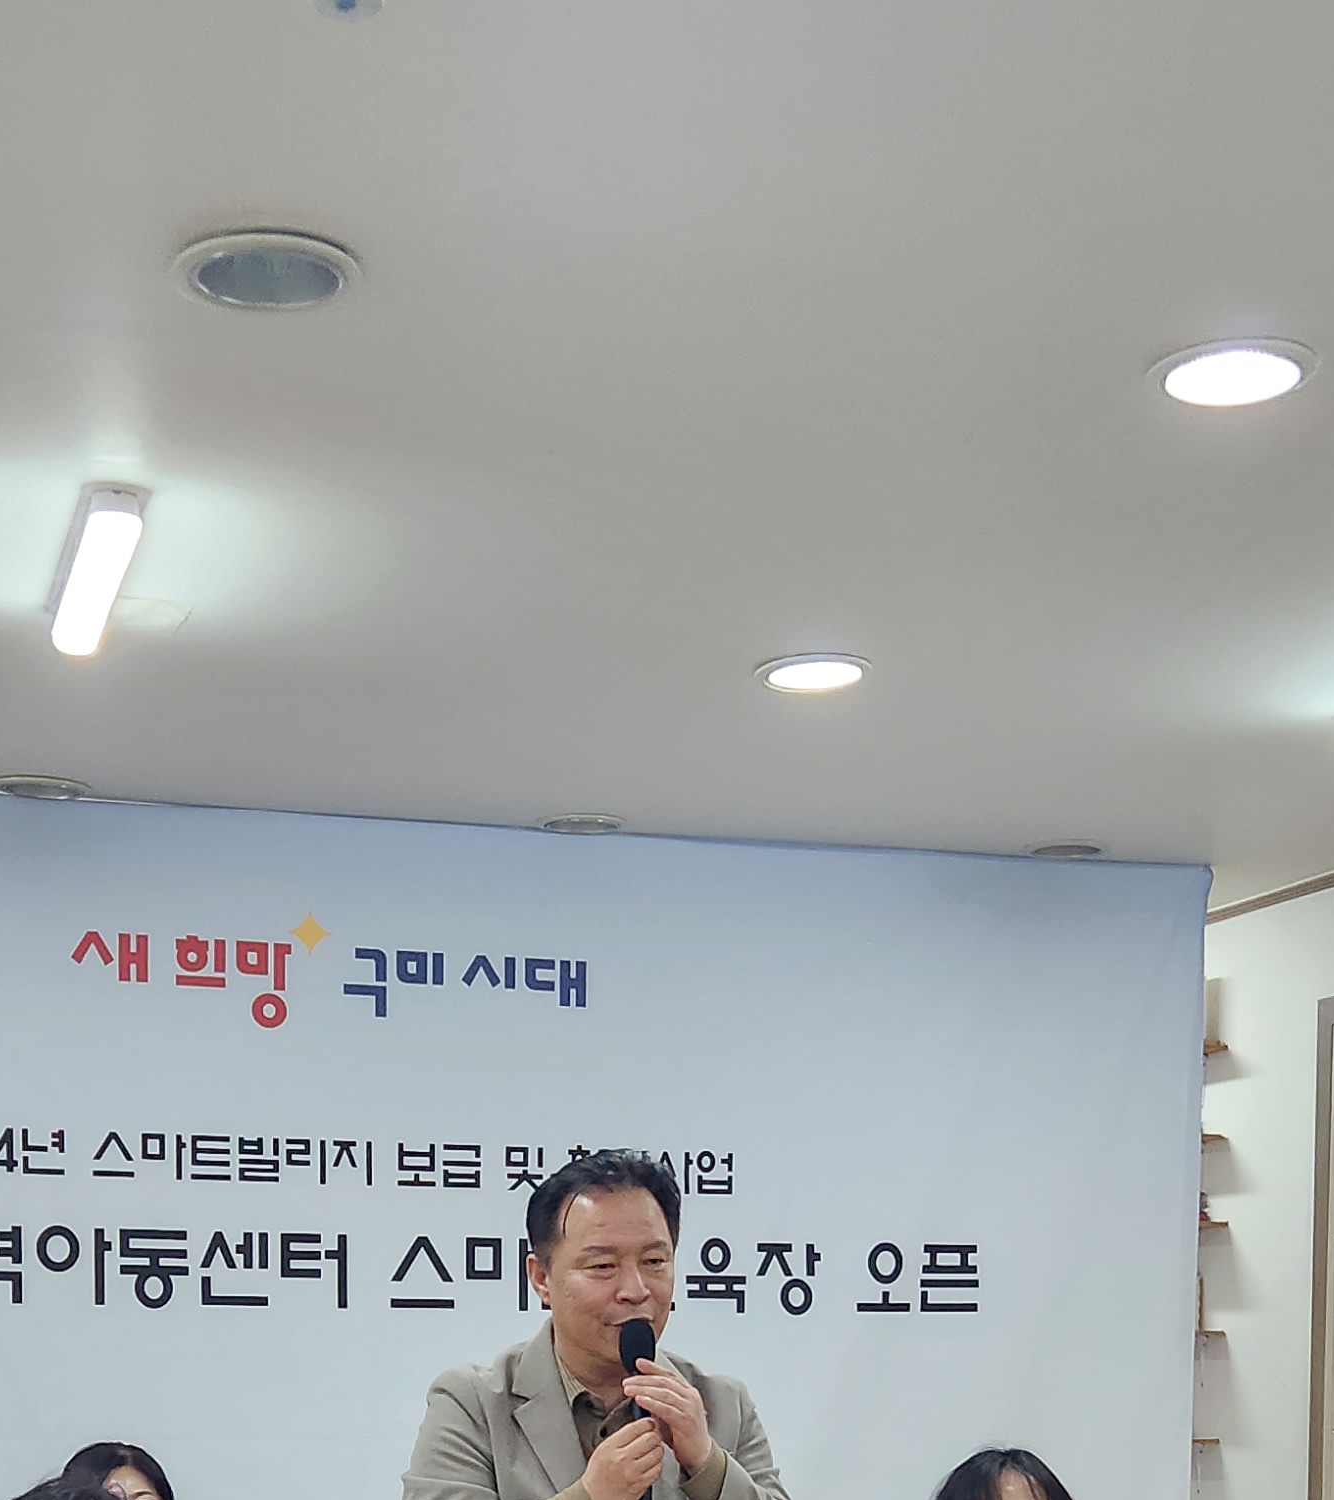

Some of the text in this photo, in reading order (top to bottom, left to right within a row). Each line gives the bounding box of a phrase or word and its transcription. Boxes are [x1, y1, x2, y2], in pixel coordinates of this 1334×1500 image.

[70, 929, 588, 1029] 새 희망 구미 시대
[91, 1130, 374, 1187] 스마트빌리지
[397, 1141, 483, 1190] 보급
[505, 1145, 546, 1192] 및
[389, 1235, 822, 1316] 스마육장
[856, 1241, 980, 1313] 오픈
